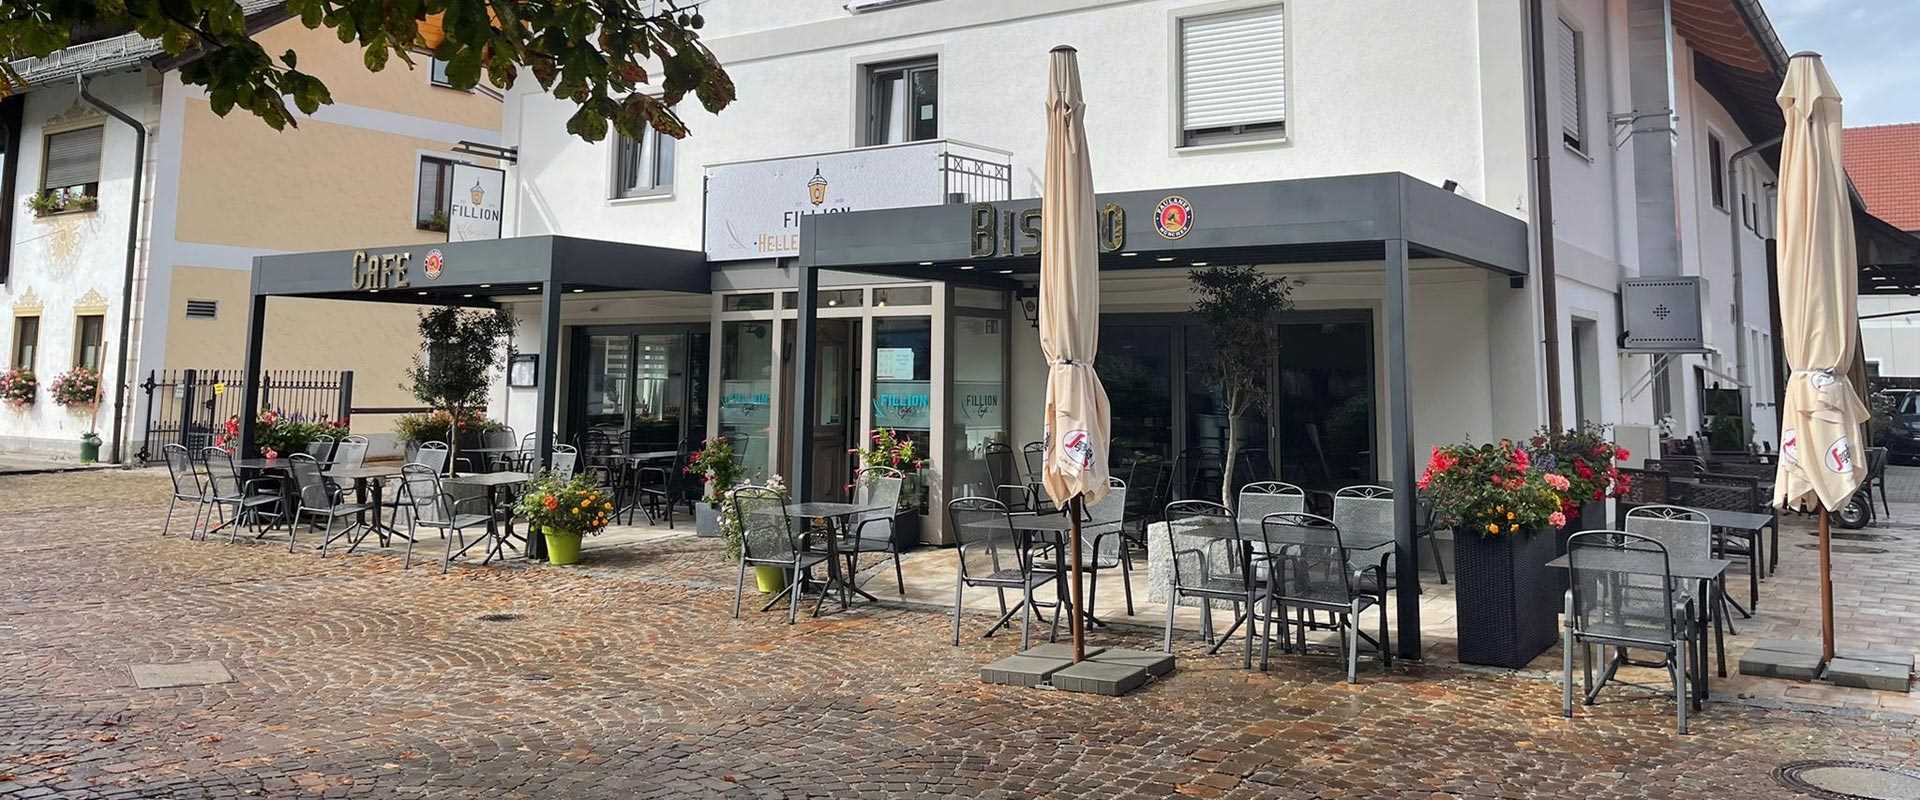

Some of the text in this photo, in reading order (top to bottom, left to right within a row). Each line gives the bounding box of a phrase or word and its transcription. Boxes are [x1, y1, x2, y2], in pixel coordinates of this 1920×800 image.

[451, 204, 500, 221] FILLION
[970, 201, 1125, 257] BISO
[880, 393, 929, 407] FILLION
[966, 394, 998, 407] FILLION
